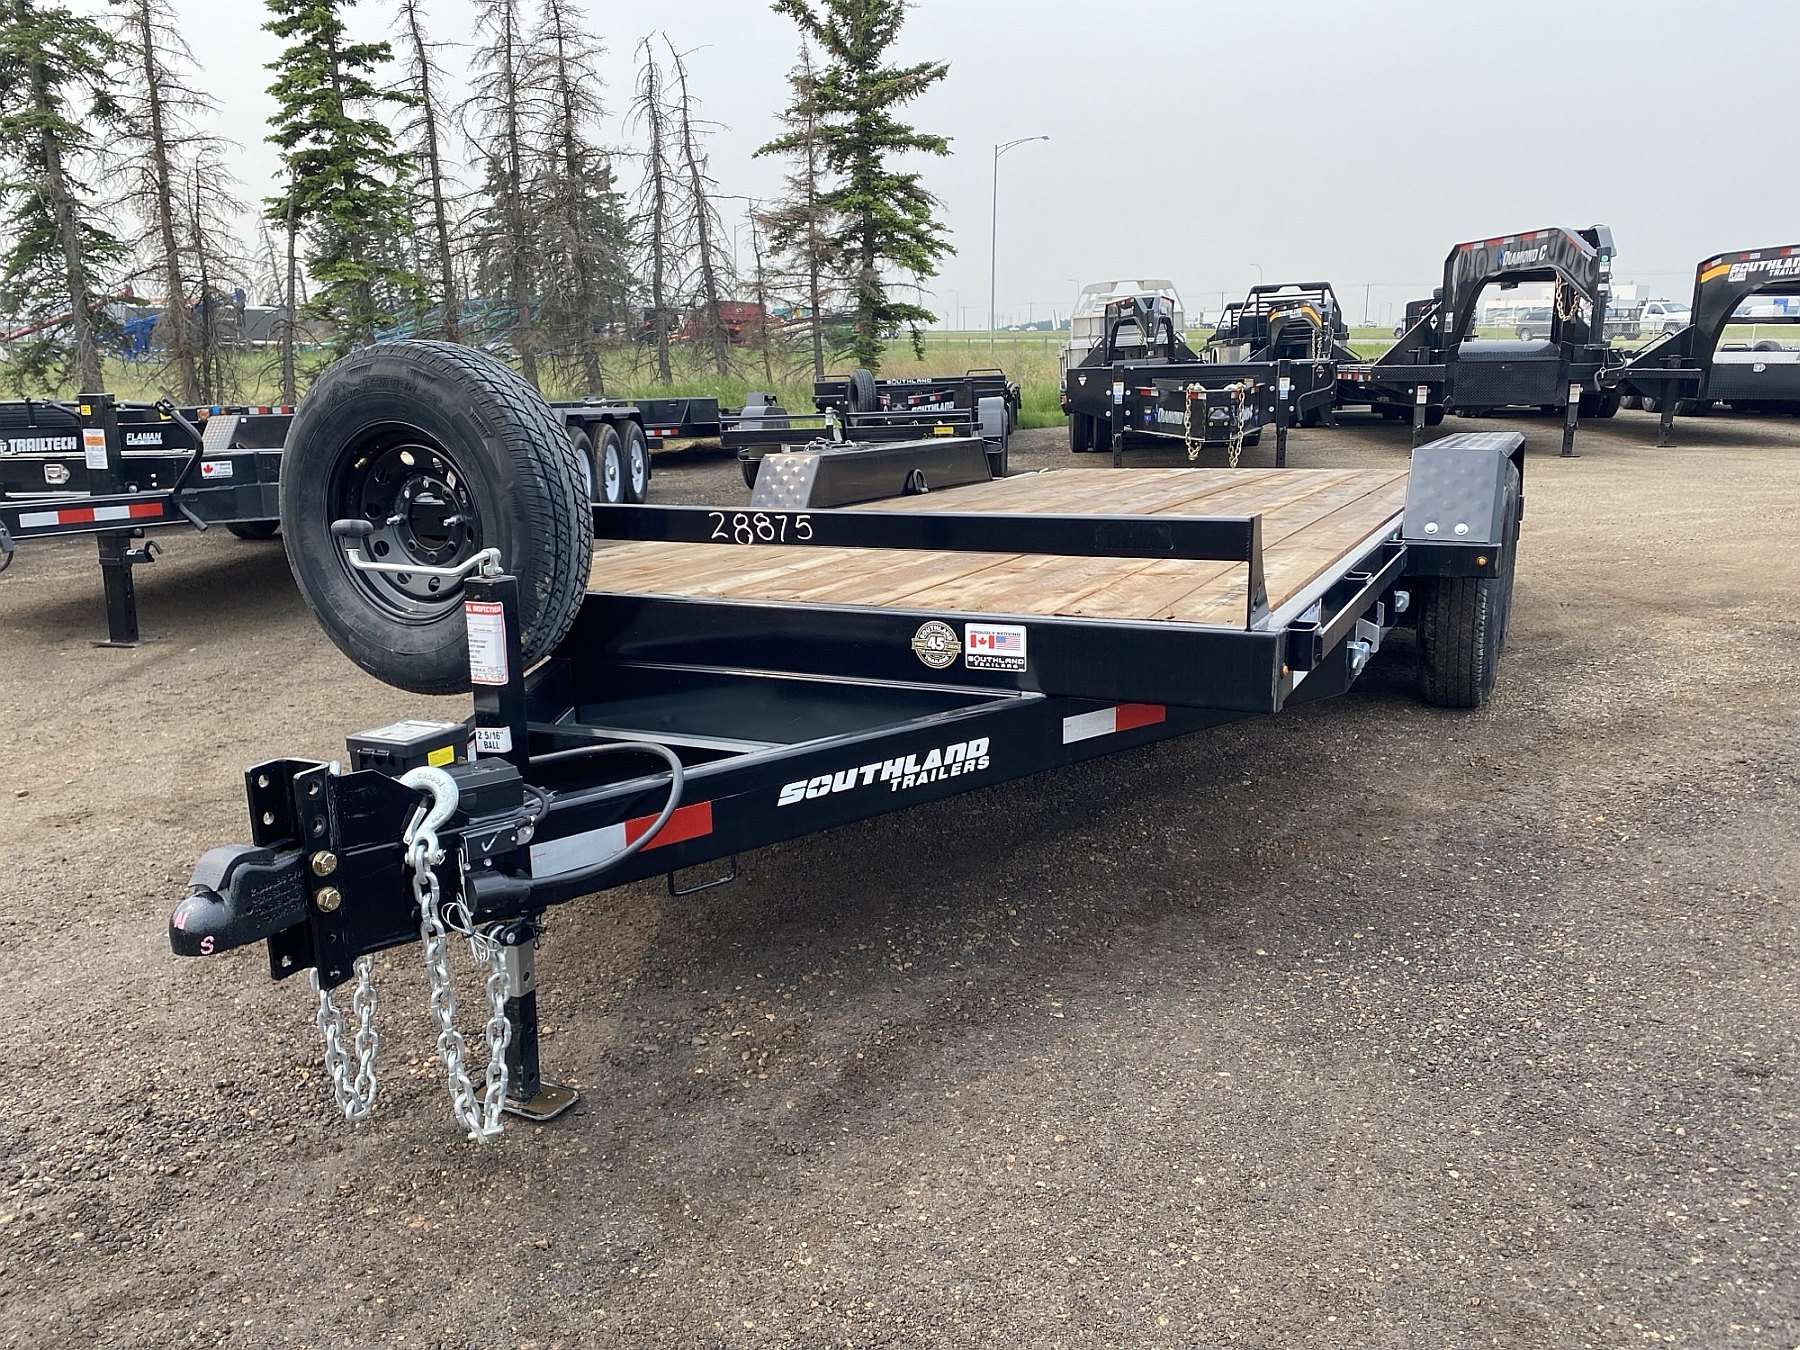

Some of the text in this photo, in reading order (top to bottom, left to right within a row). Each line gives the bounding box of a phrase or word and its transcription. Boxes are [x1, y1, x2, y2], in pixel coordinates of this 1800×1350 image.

[1503, 245, 1547, 265] DIAMOND C
[8, 436, 77, 453] TRAILTECH
[126, 432, 162, 441] FLAMAN
[708, 512, 813, 545] 28875
[919, 625, 953, 641] SOUTHLAND
[927, 636, 945, 651] 45
[967, 655, 1024, 665] SOUTHLAND
[477, 731, 483, 740] 2
[483, 741, 500, 749] BALL
[777, 737, 990, 807] SOUTHLAND
[890, 755, 990, 792] TRAILERS
[200, 935, 214, 955] S
